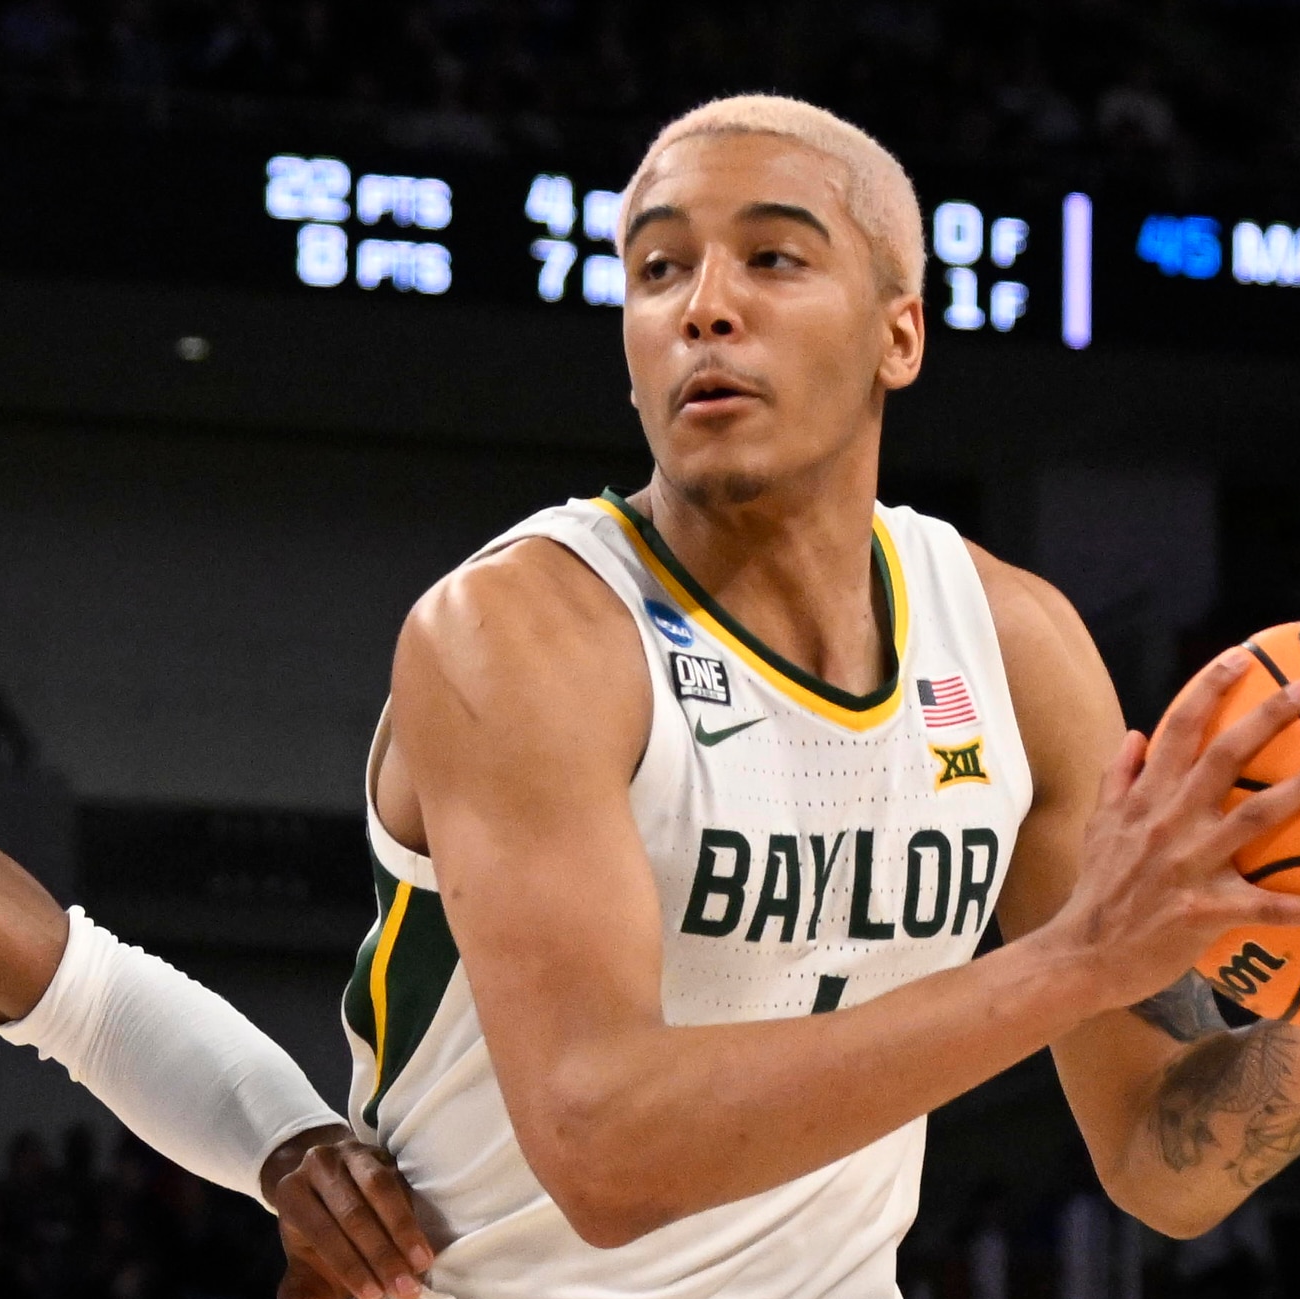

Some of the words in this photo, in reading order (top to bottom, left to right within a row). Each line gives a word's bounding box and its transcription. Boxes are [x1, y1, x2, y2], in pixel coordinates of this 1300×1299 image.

[265, 155, 351, 223] 22
[356, 173, 452, 231] PTS
[525, 174, 577, 239] 4
[933, 202, 984, 267] 0
[990, 217, 1030, 269] F
[356, 239, 452, 295] PTS
[530, 239, 578, 303] 7
[943, 266, 986, 331] 1
[990, 281, 1030, 333] F
[675, 654, 726, 693] ONE
[933, 742, 987, 784] XII
[680, 827, 999, 943] BAYLOR
